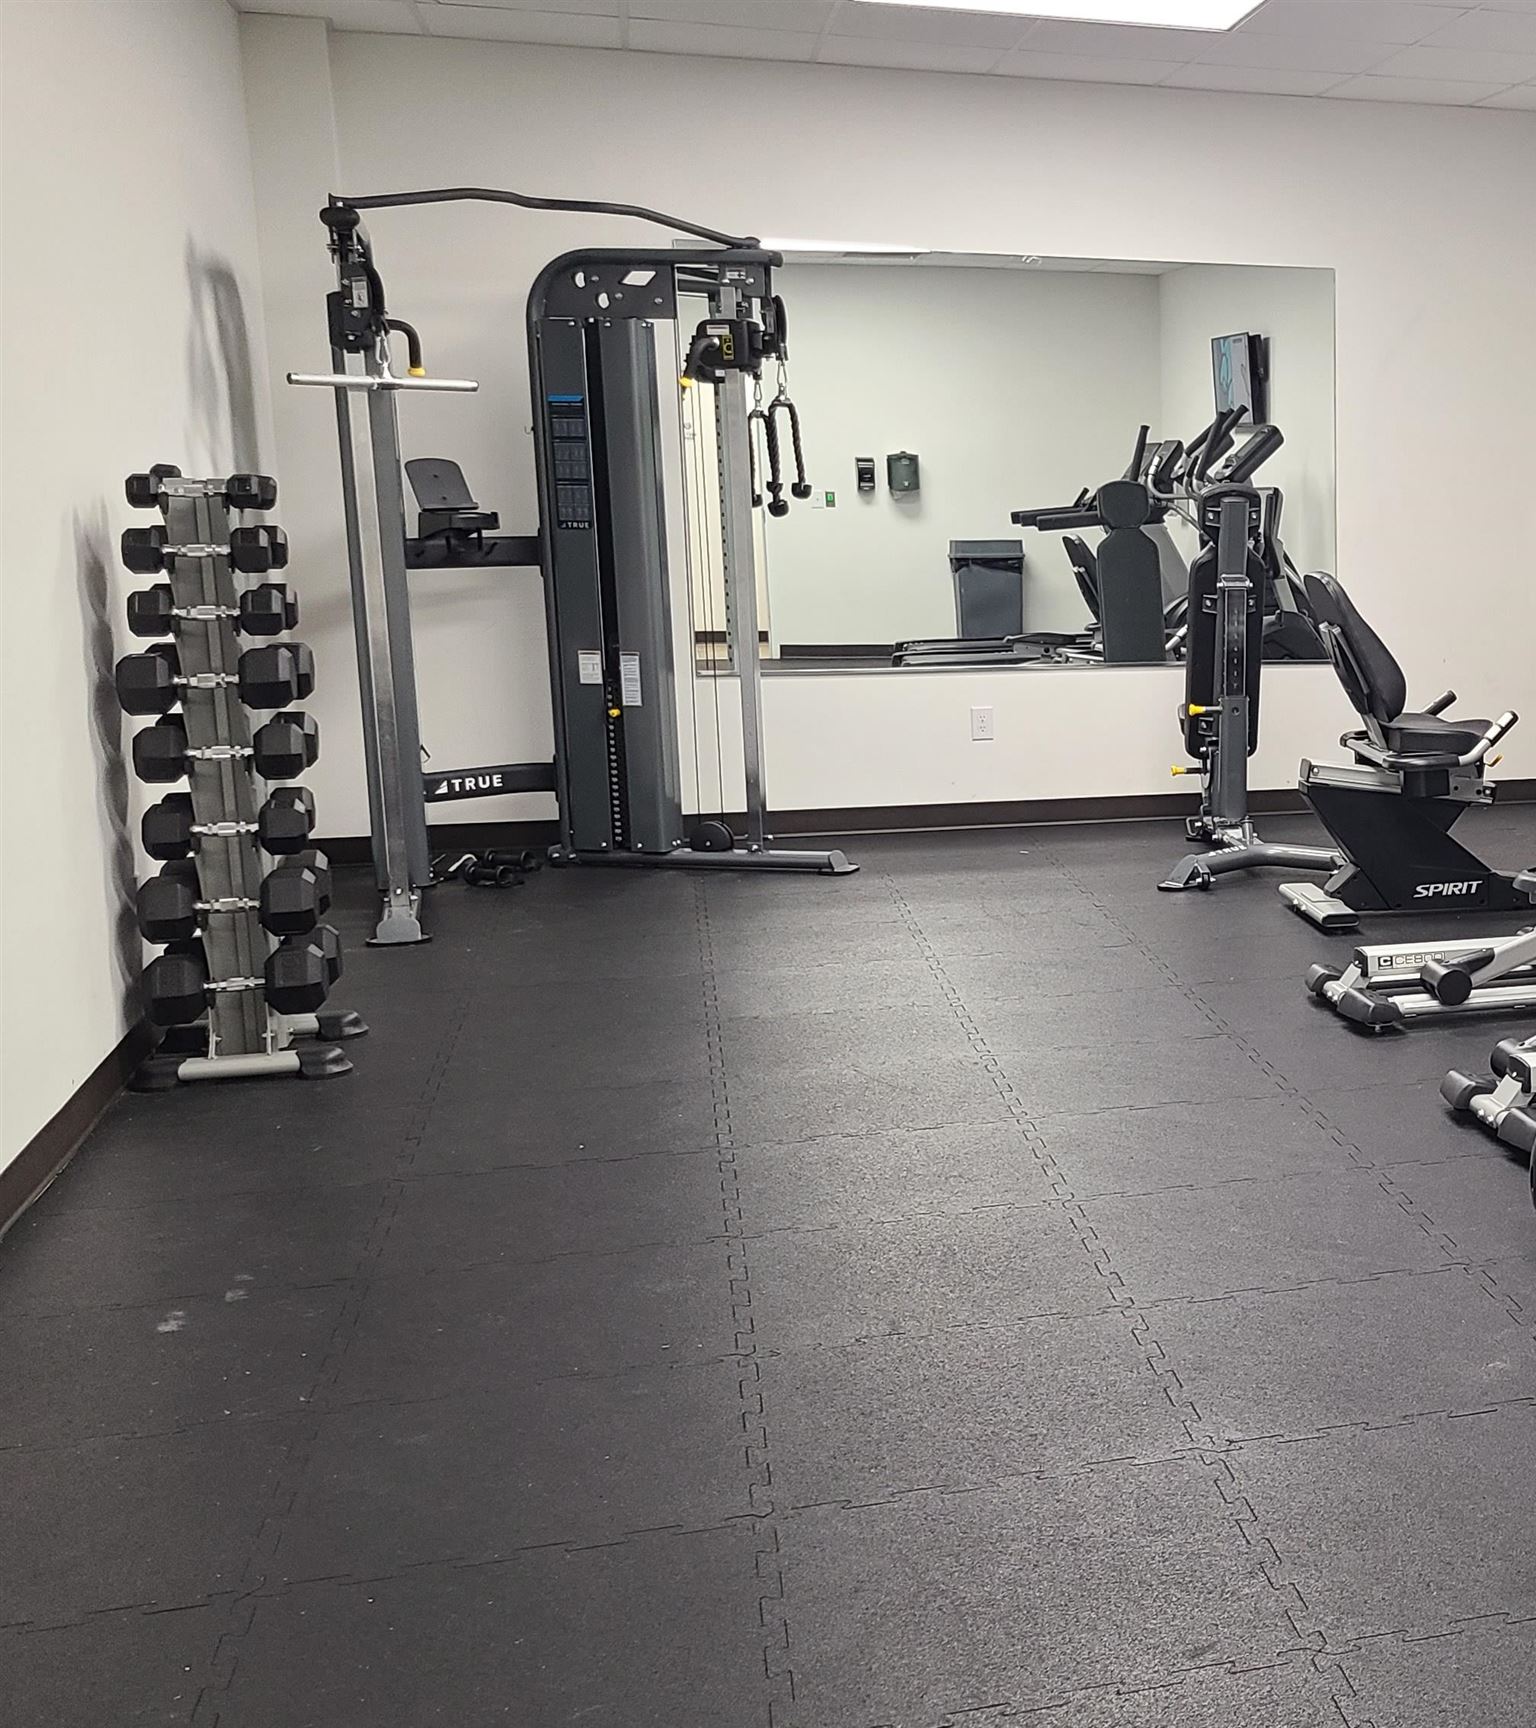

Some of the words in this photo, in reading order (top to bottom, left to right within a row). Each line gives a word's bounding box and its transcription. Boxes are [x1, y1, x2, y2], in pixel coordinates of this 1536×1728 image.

[567, 521, 590, 529] TRUE
[451, 774, 503, 792] TRUE
[1412, 880, 1484, 898] SPIRIT
